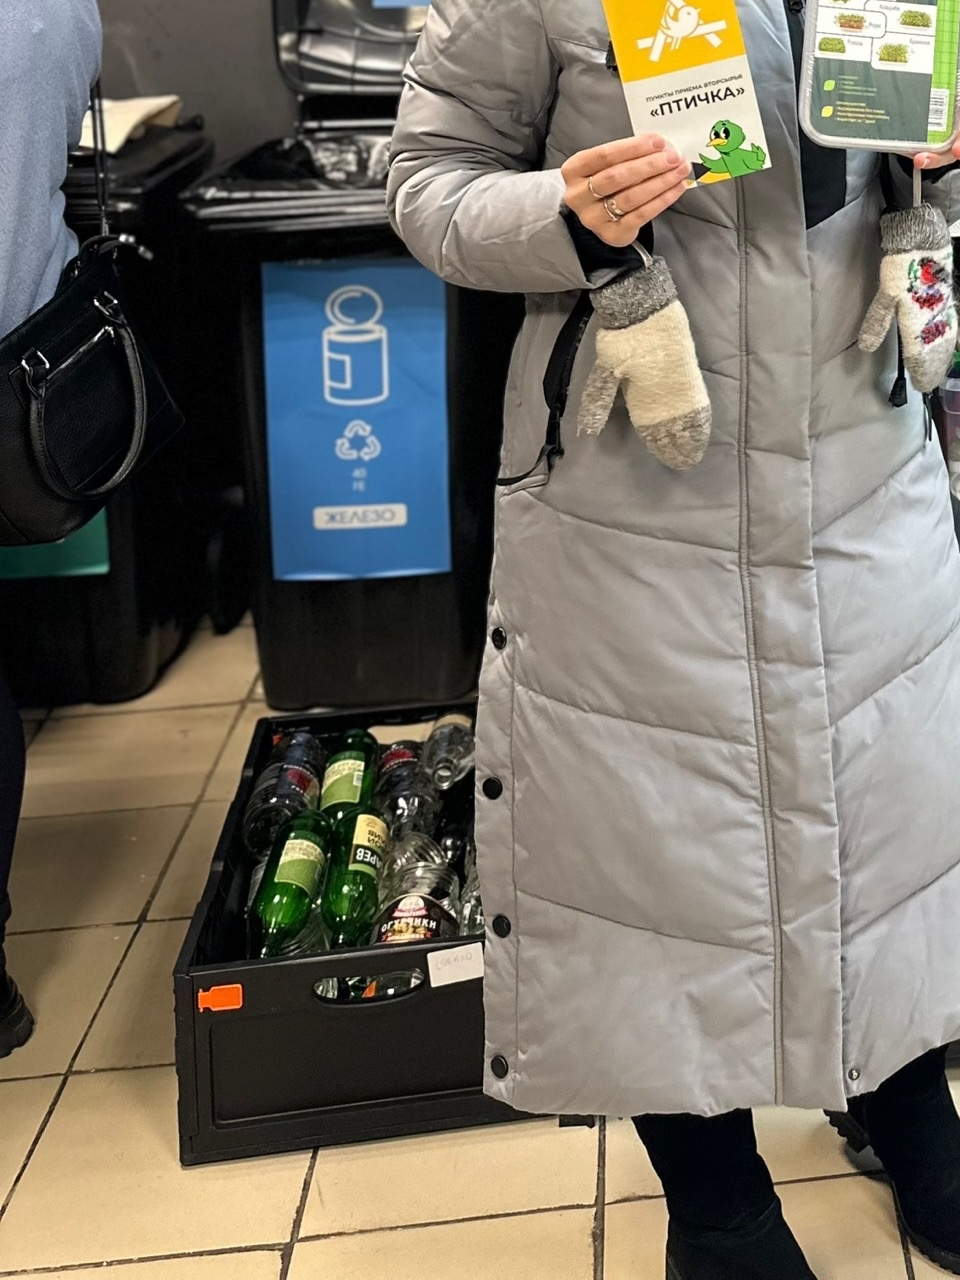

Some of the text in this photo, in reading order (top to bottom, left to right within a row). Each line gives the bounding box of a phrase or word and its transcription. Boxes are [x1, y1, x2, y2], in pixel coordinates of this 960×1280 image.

[646, 74, 743, 102] ПУНКТЫ ПРИЕМА ВТОРСЫРЬЯ
[650, 86, 745, 117] «ПТИЧКА»
[324, 508, 396, 525] ЖЕЛЕЗО
